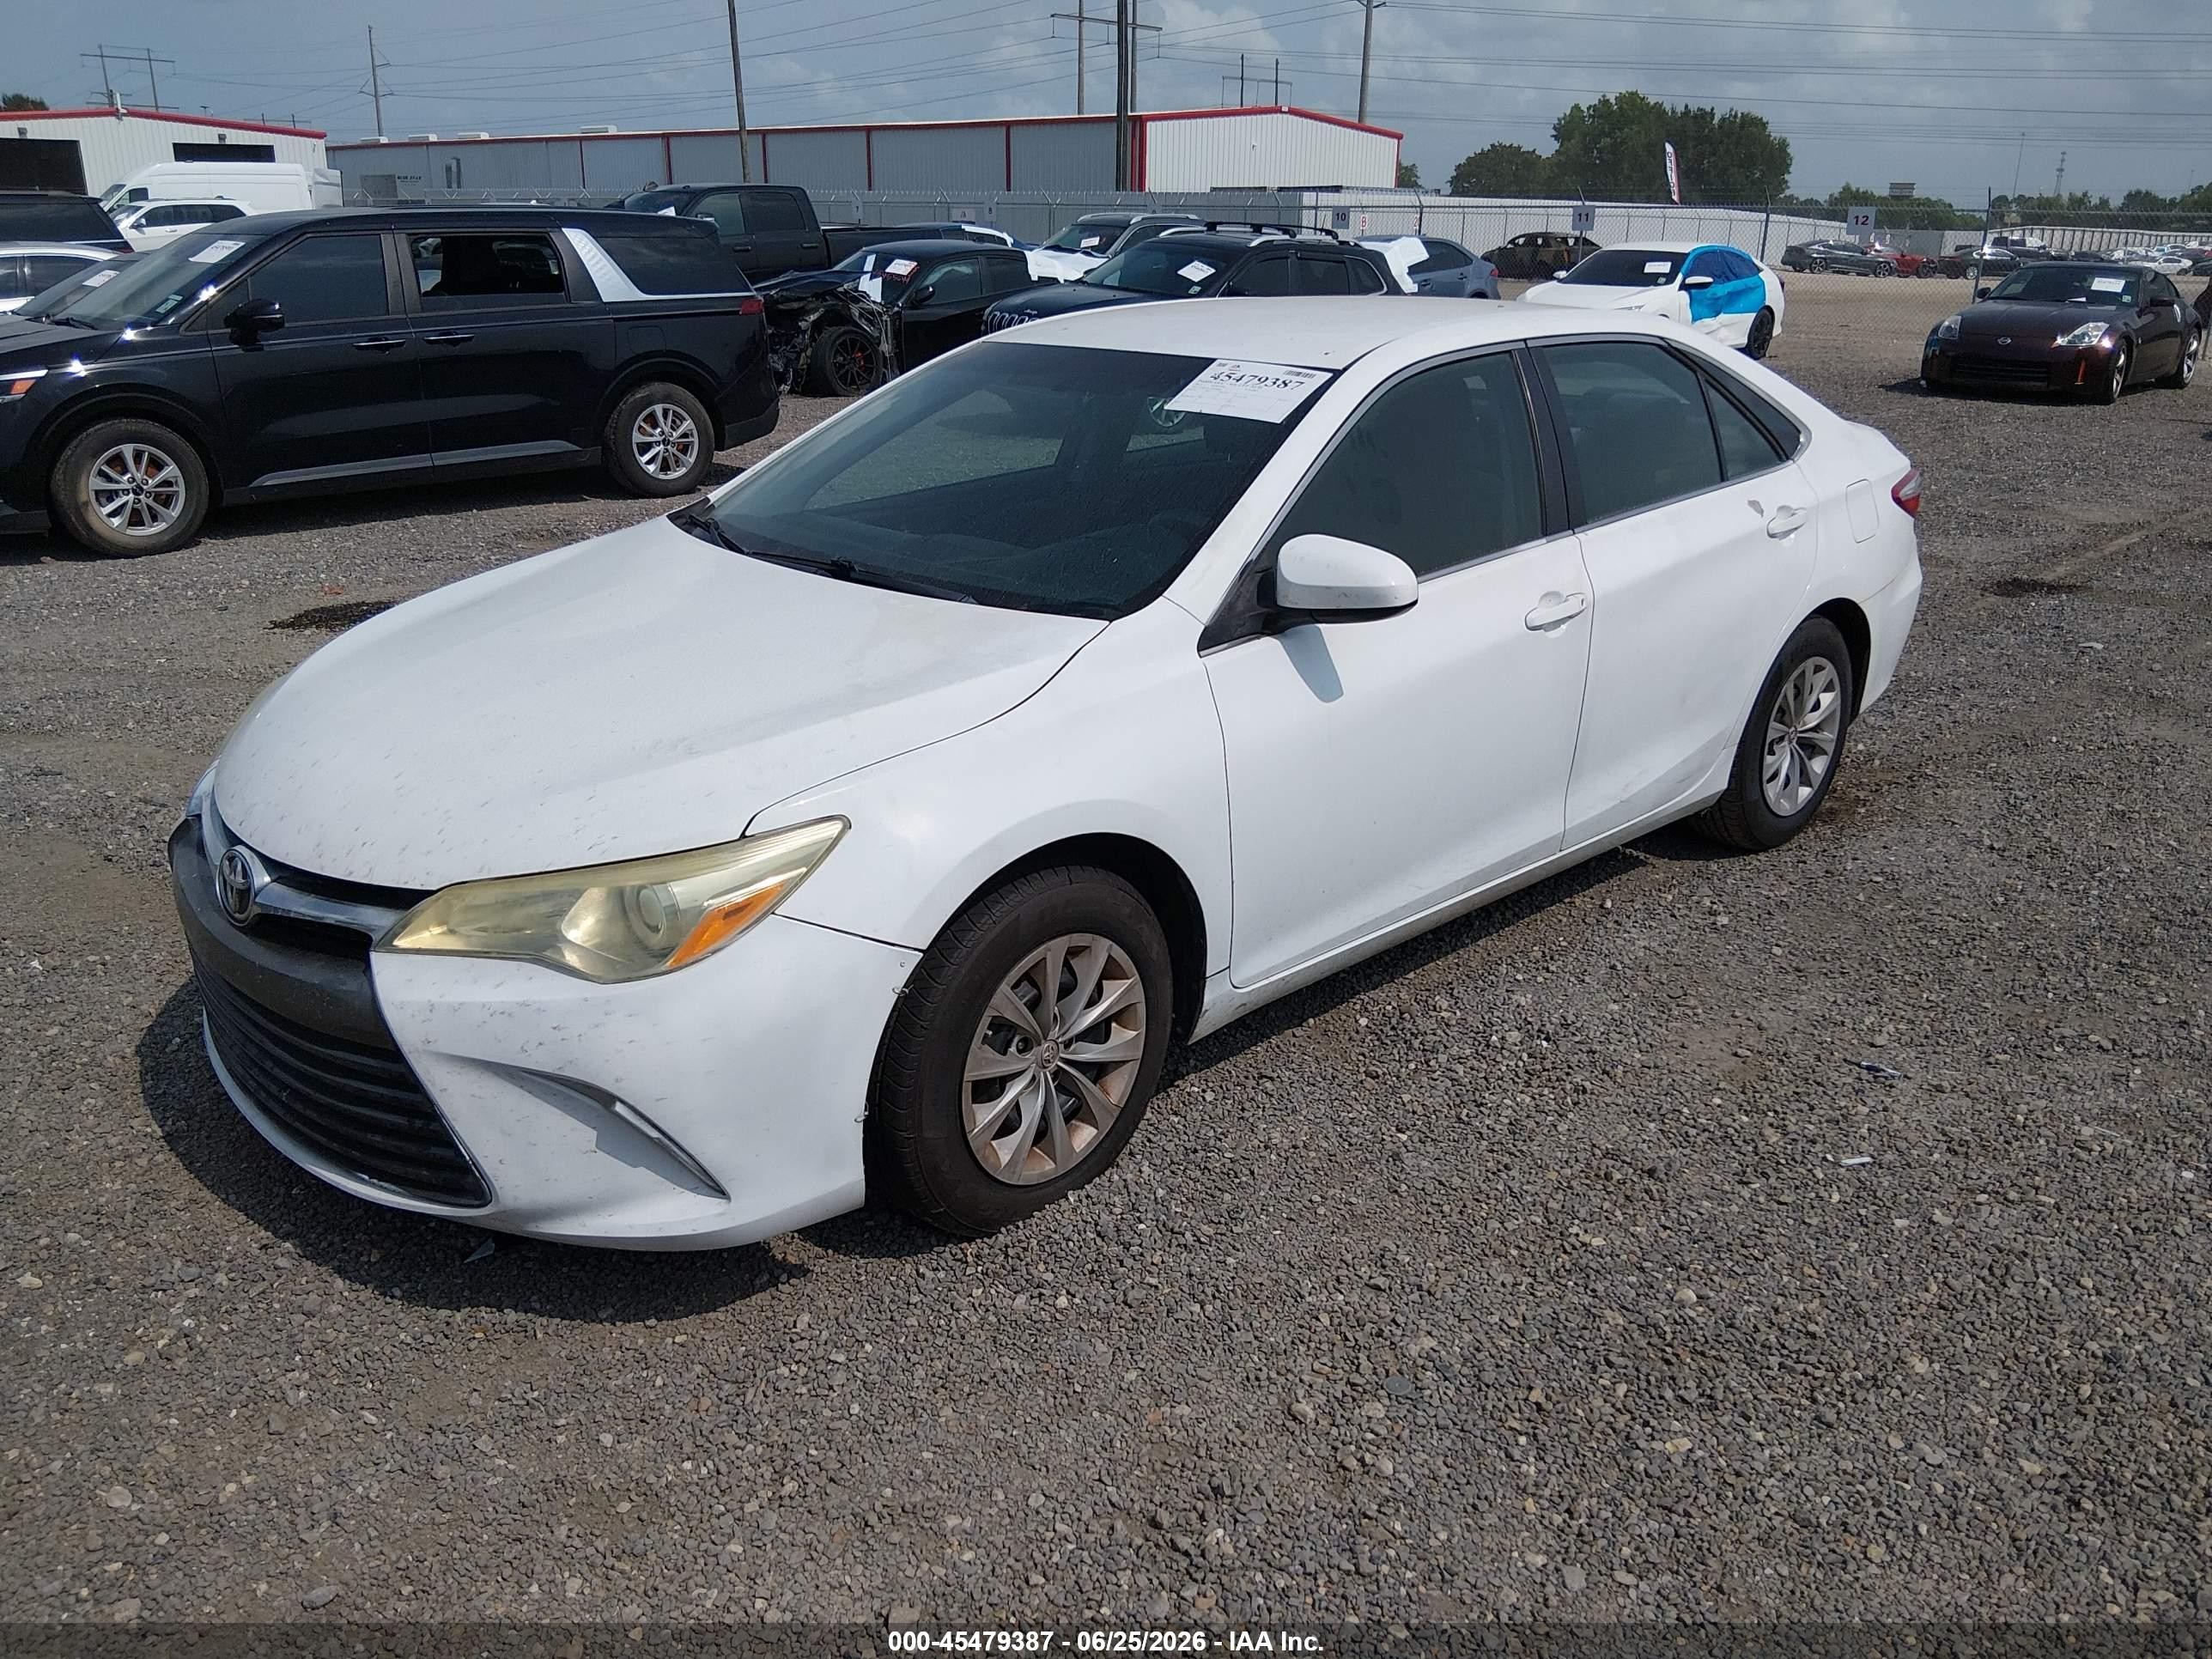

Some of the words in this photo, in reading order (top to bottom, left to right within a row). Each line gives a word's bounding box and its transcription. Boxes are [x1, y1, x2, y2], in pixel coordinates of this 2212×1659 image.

[1335, 212, 1346, 222] 10
[1577, 212, 1589, 222] 11
[1853, 215, 1869, 226] 12
[1210, 371, 1305, 390] 45479387
